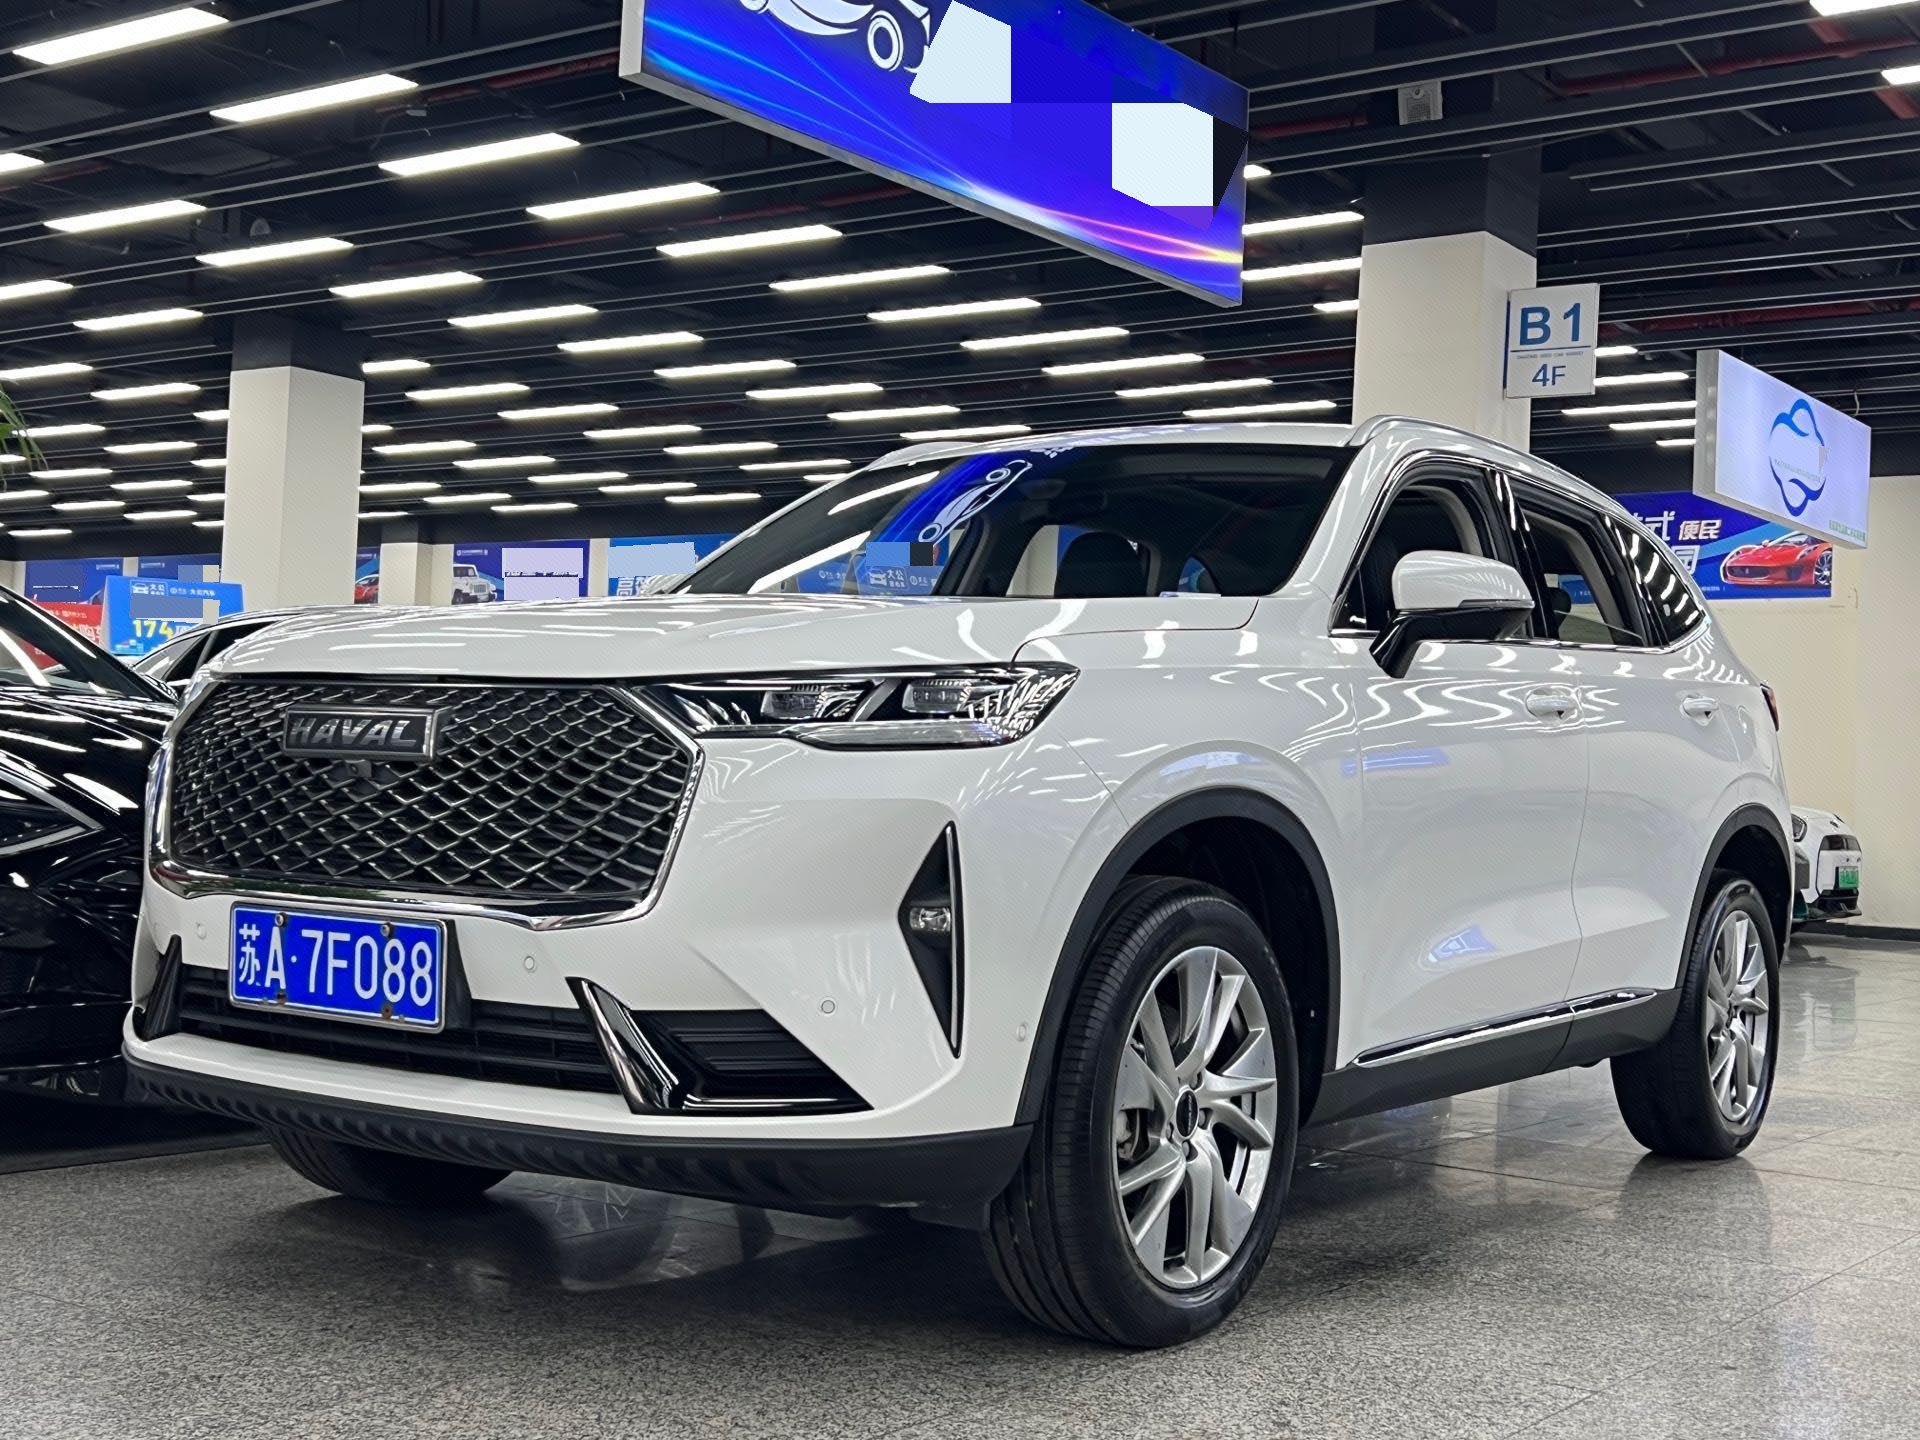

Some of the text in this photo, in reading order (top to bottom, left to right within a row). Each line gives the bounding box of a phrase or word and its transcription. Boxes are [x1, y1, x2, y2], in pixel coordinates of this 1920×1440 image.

[1532, 363, 1567, 387] 4F
[1679, 520, 1722, 541] 便民
[288, 717, 417, 747] HAVAL
